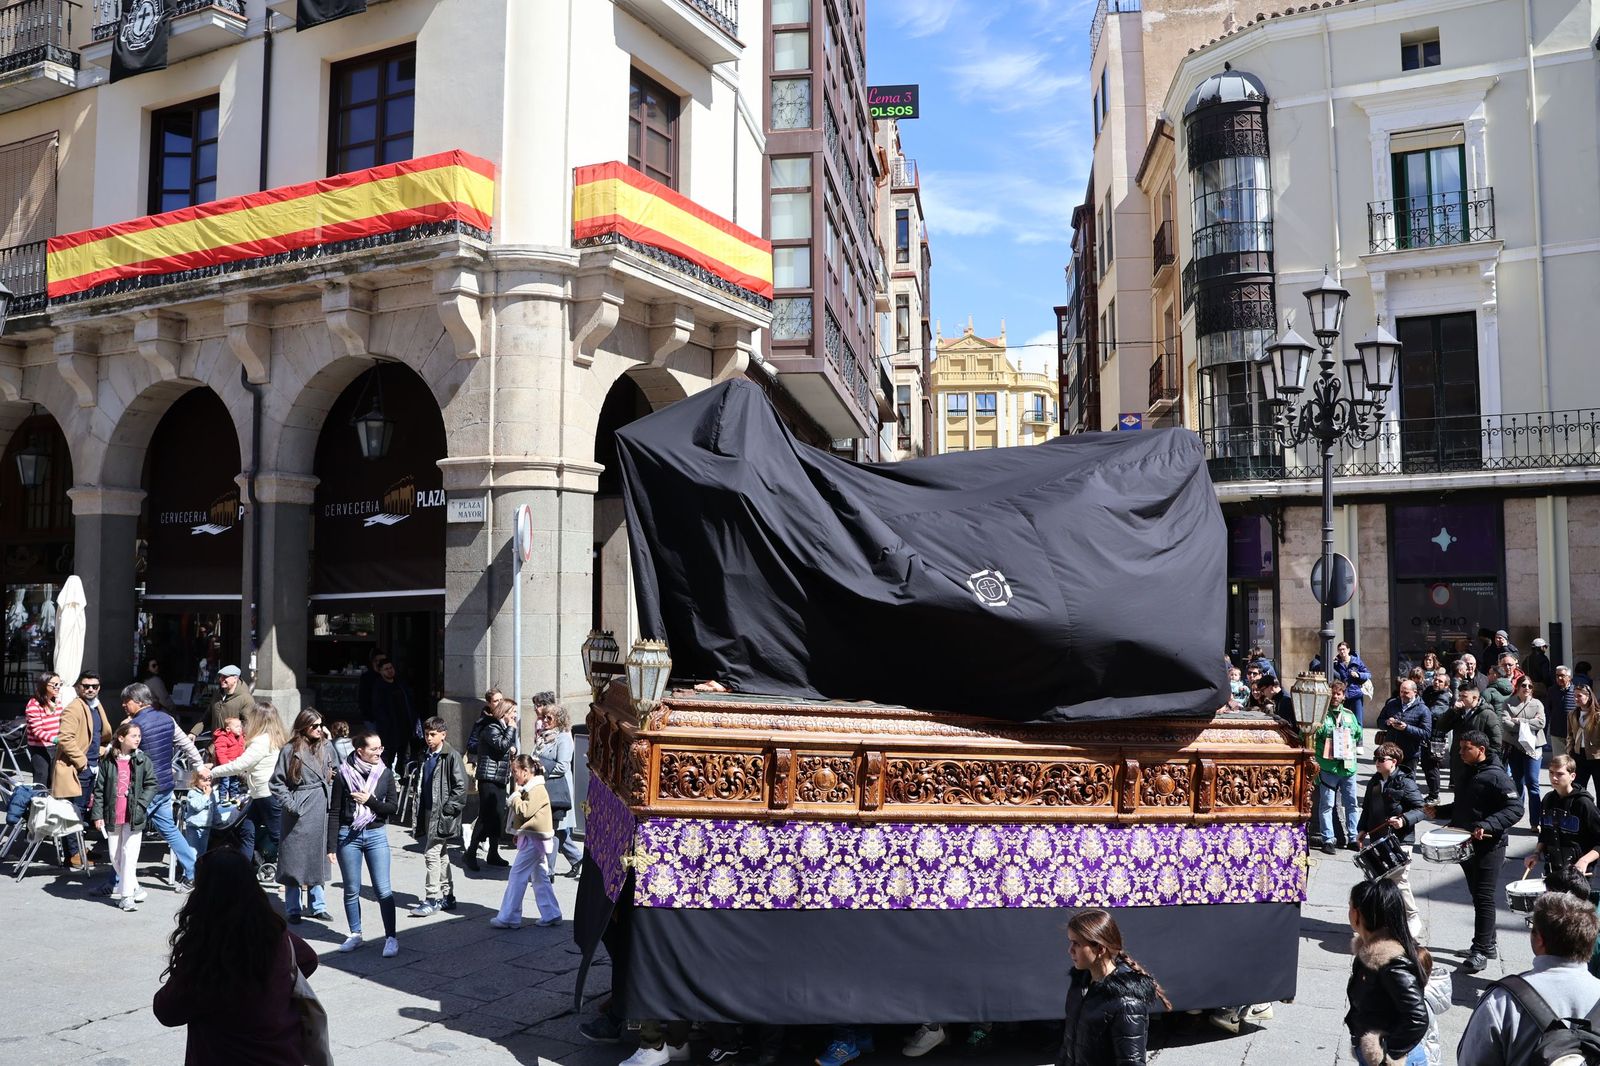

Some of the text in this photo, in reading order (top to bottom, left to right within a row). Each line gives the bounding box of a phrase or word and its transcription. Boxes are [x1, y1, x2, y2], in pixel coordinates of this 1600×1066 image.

[868, 88, 912, 104] Lema 3
[870, 105, 913, 117] OLSOS
[416, 489, 446, 508] PLAZA
[458, 501, 481, 509] PLAZA
